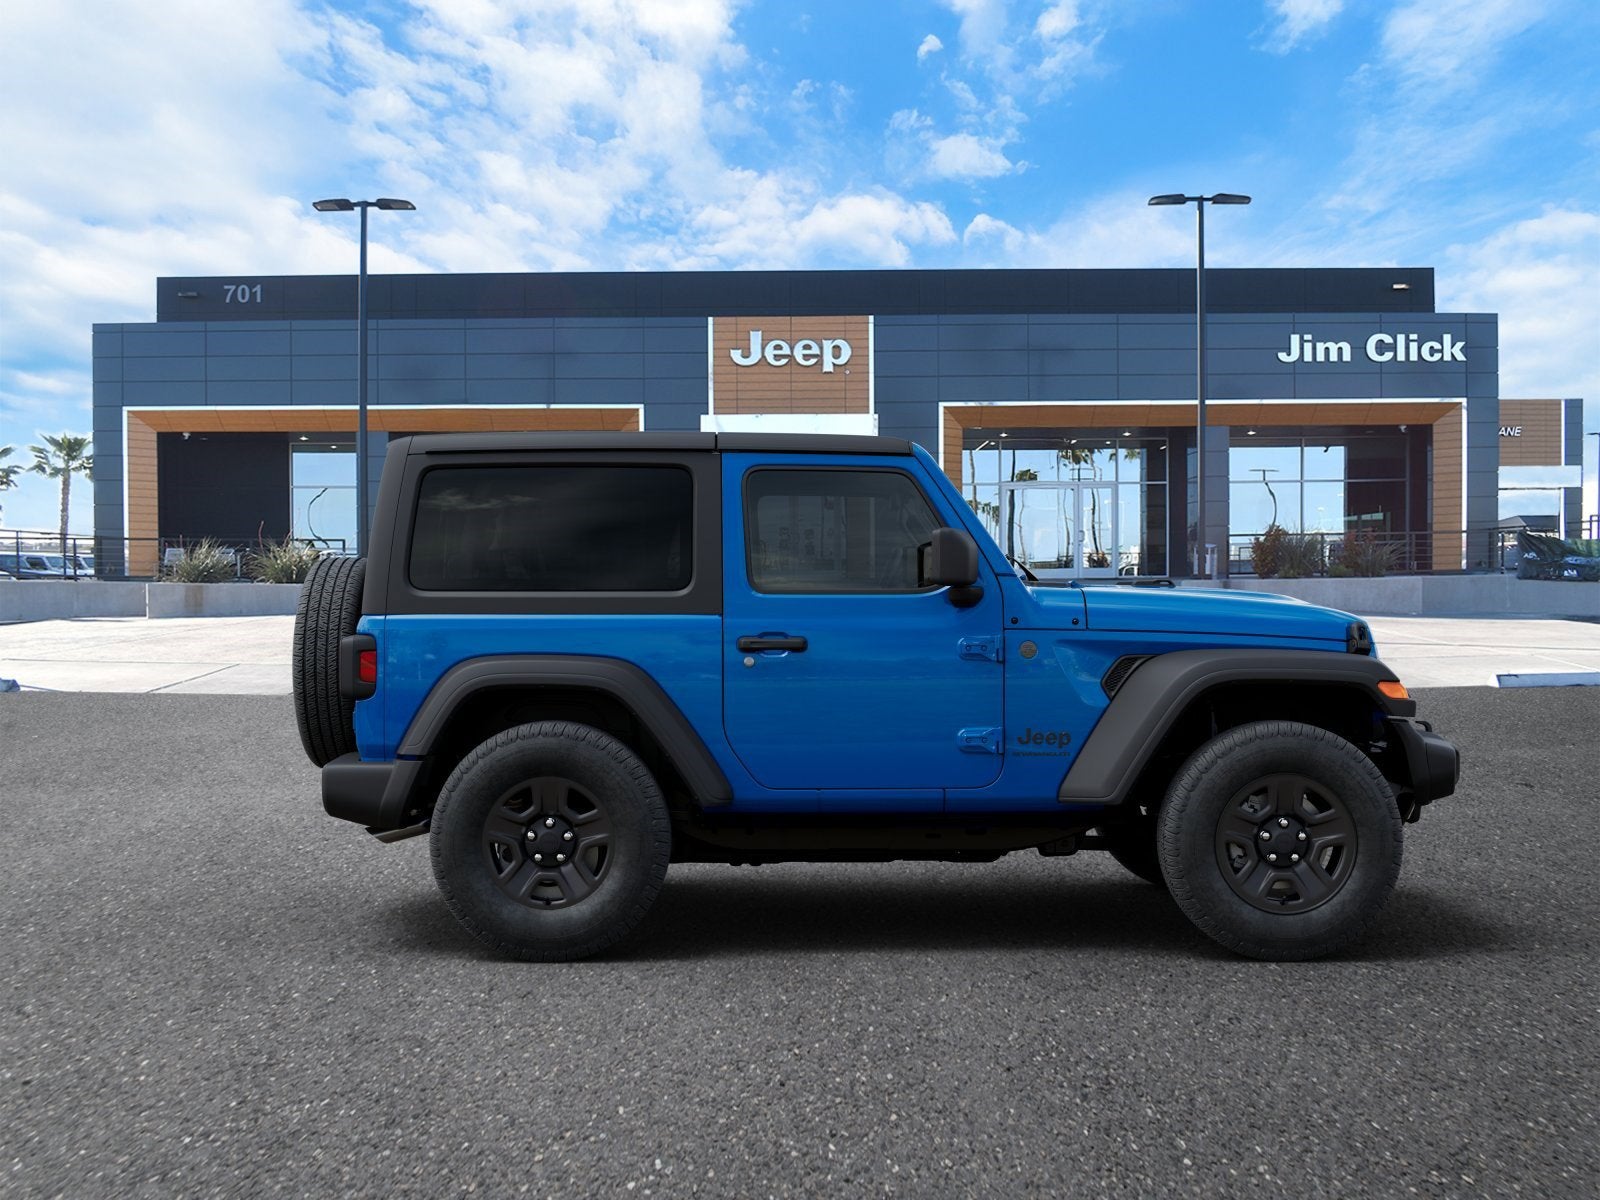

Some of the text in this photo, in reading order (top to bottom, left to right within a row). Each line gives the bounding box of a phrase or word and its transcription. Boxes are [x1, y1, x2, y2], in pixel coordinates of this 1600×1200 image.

[223, 284, 262, 303] 701
[730, 330, 852, 373] Jeep
[1277, 333, 1467, 363] Jim Click
[1017, 727, 1071, 749] Jeep
